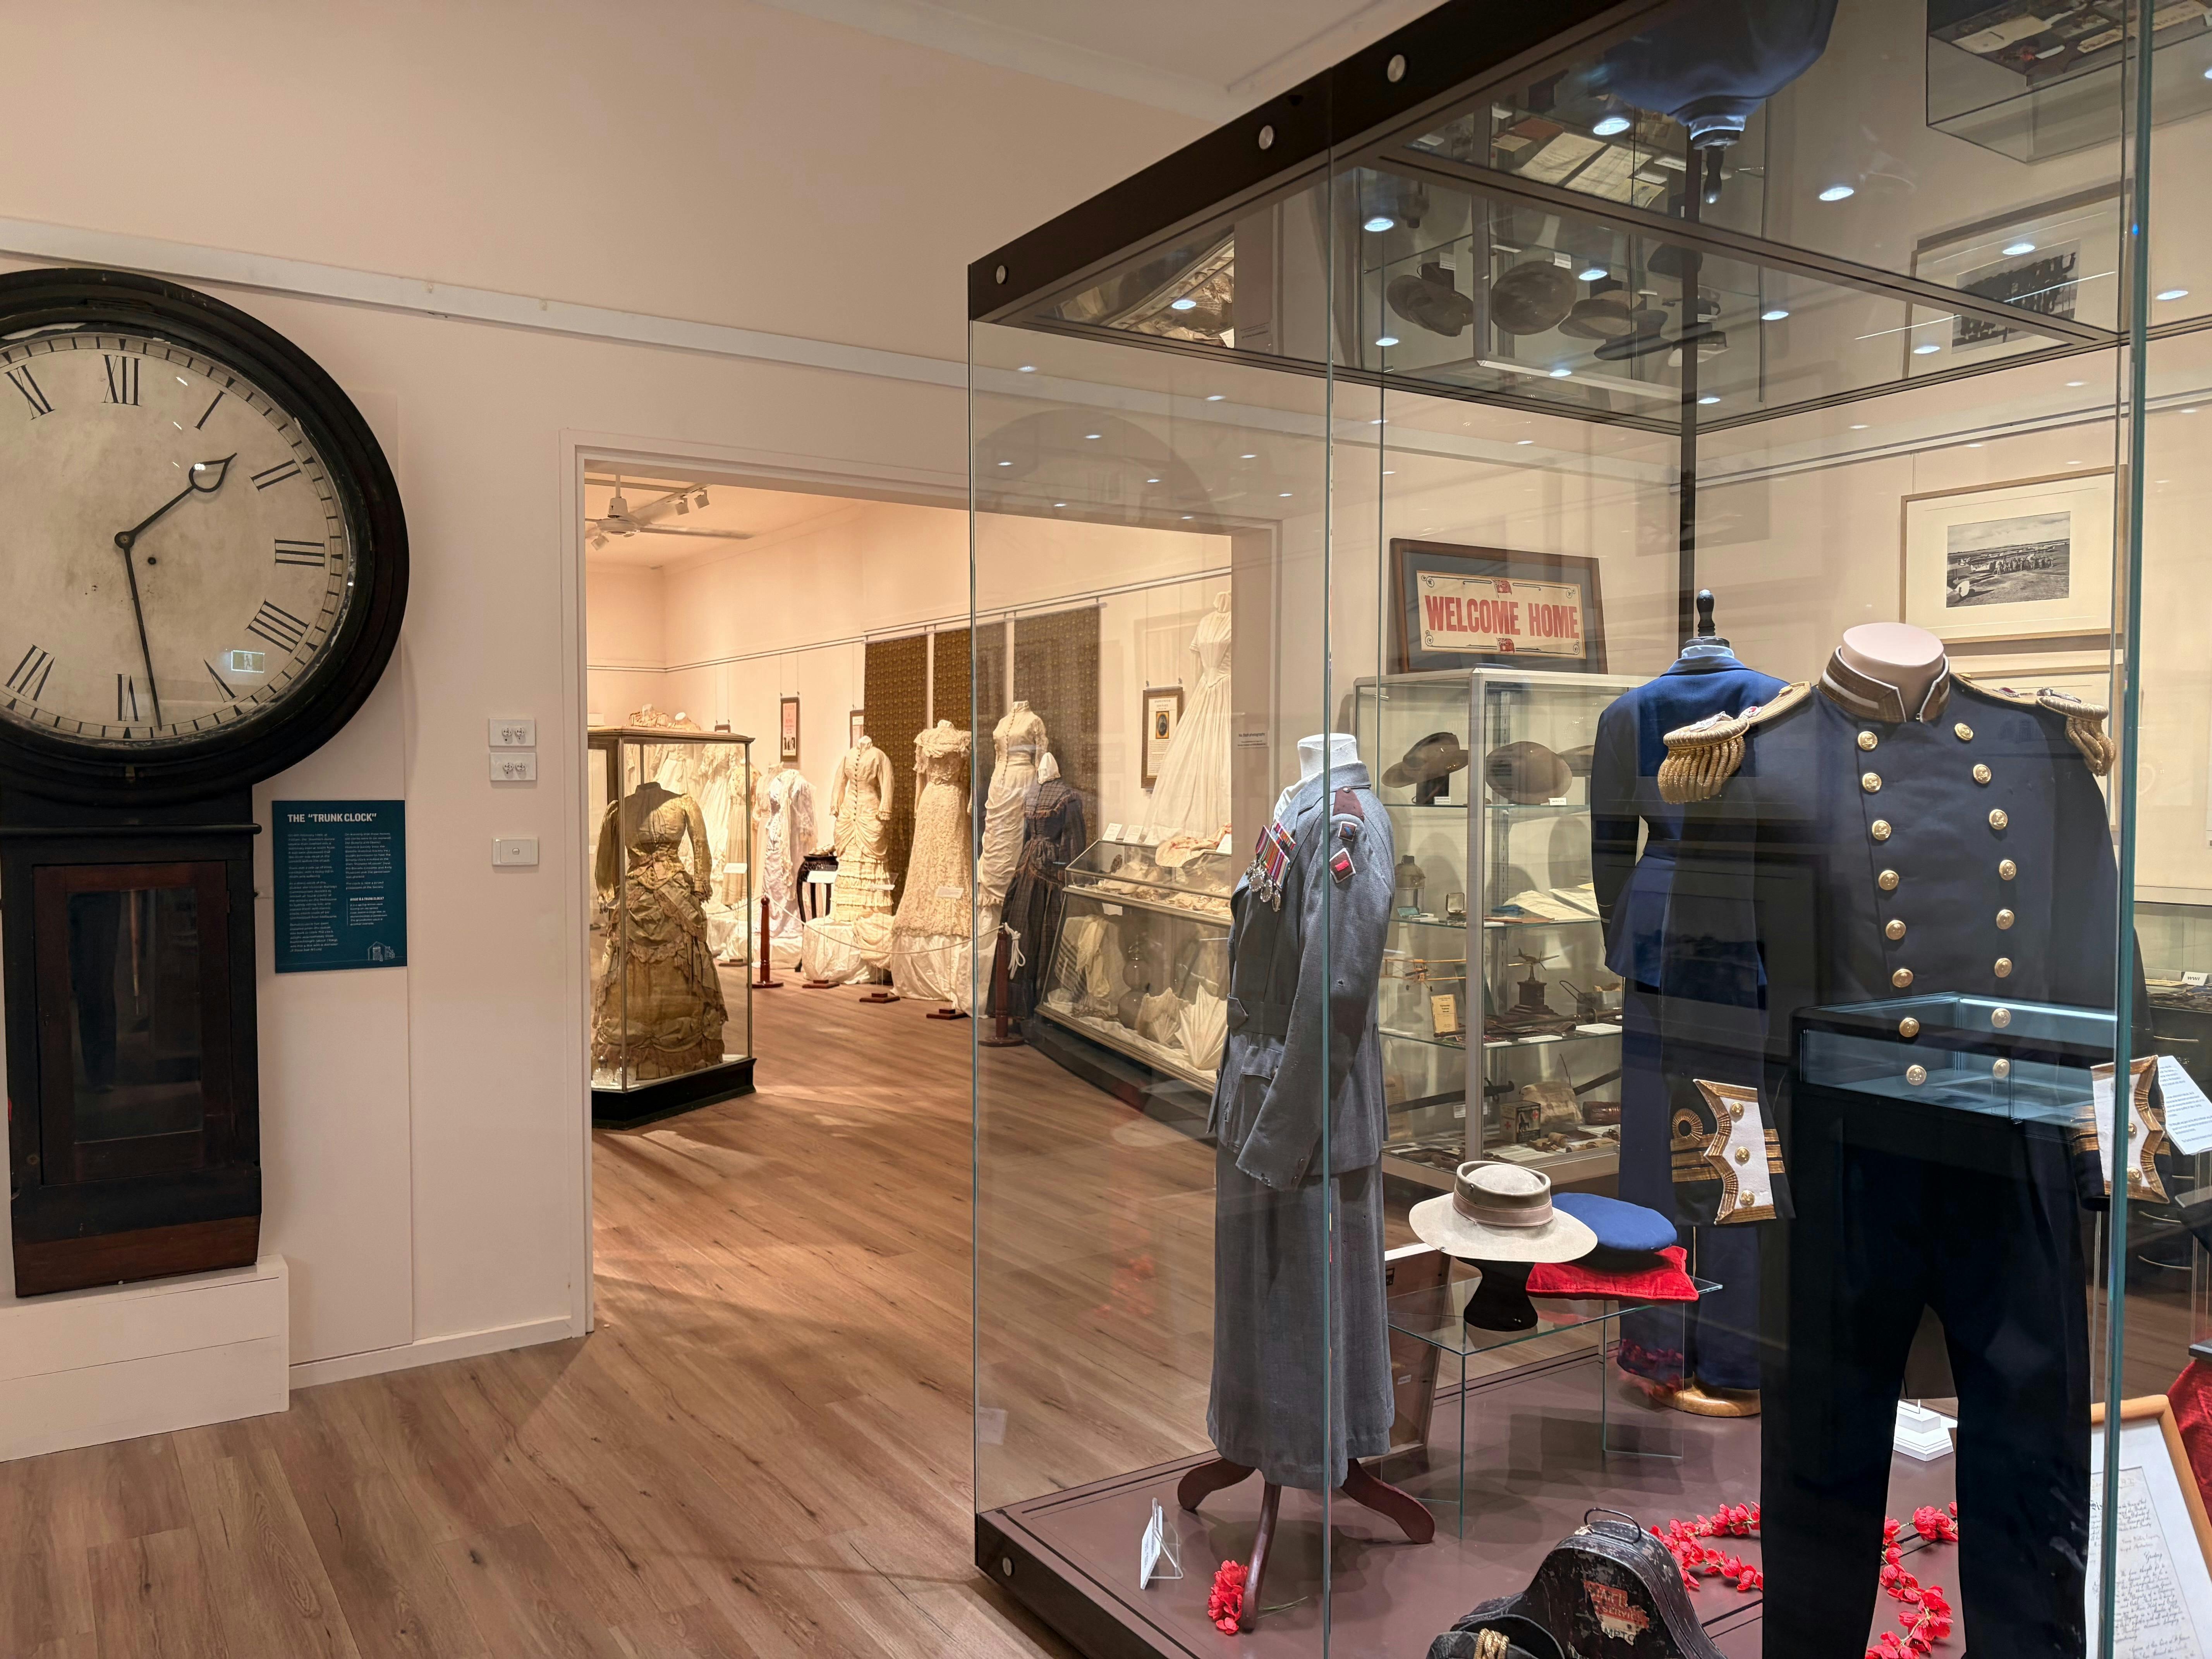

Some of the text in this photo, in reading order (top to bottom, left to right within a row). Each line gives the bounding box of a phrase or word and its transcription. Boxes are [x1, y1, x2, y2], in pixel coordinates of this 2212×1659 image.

[5, 364, 55, 421] XI
[101, 354, 142, 407] XII
[194, 389, 227, 431] I
[249, 458, 302, 492] II
[274, 538, 325, 569] III
[1425, 595, 1580, 639] WELCOME HOME
[287, 814, 305, 823] THE
